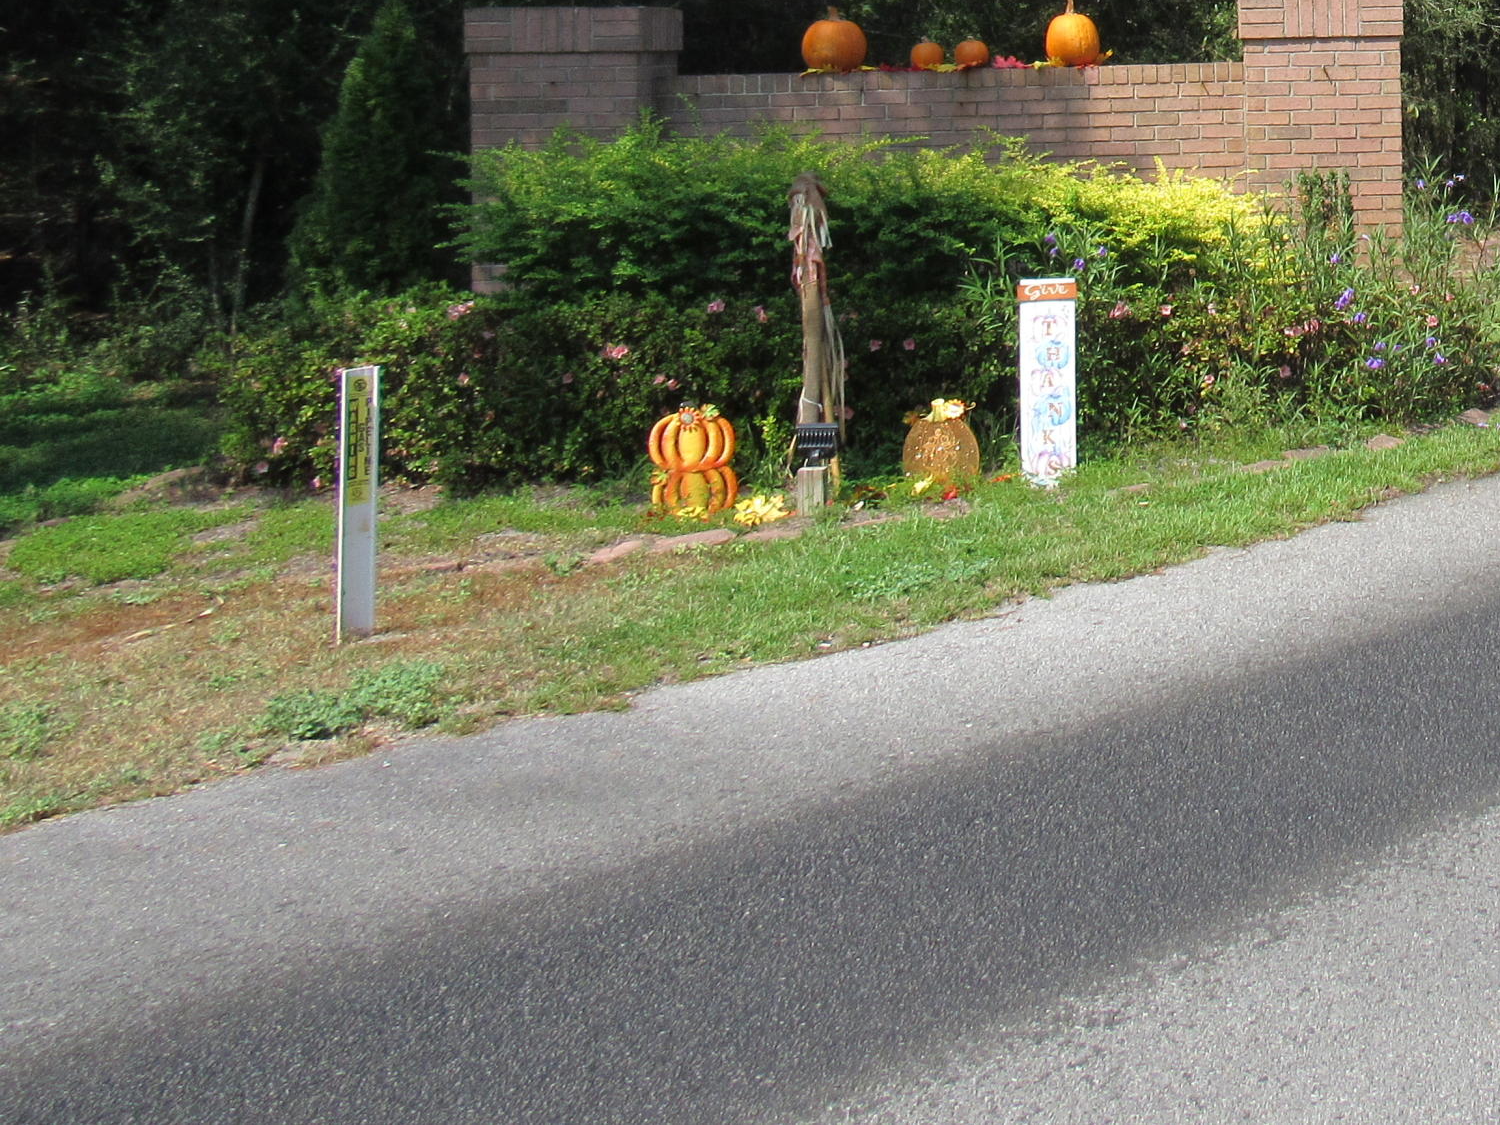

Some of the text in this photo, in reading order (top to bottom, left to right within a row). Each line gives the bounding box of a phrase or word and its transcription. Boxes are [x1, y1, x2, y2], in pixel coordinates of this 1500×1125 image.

[1024, 283, 1069, 301] Give
[1040, 320, 1063, 475] THANKS
[357, 423, 366, 452] GAS
